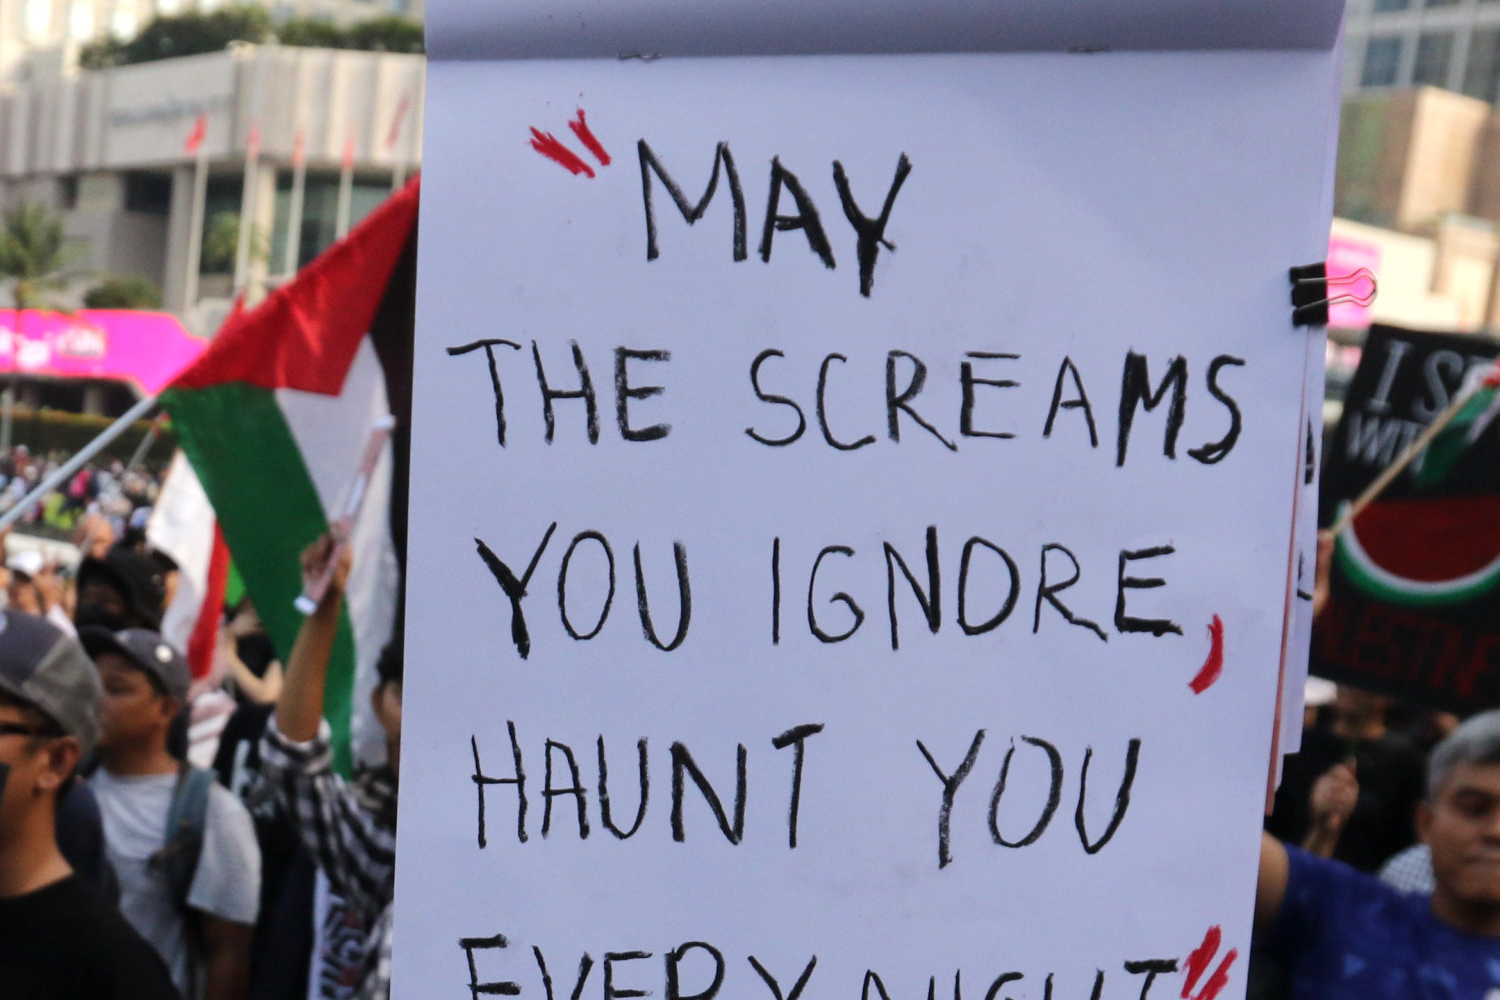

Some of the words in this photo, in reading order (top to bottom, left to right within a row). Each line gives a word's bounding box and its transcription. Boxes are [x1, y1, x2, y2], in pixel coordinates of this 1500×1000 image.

[447, 338, 669, 447] THE
[745, 348, 1246, 467] SCREAMS
[474, 521, 692, 660] YOU
[772, 525, 1224, 695] IGNORE,
[471, 720, 824, 849] HAUNT
[916, 729, 1142, 870] YOU
